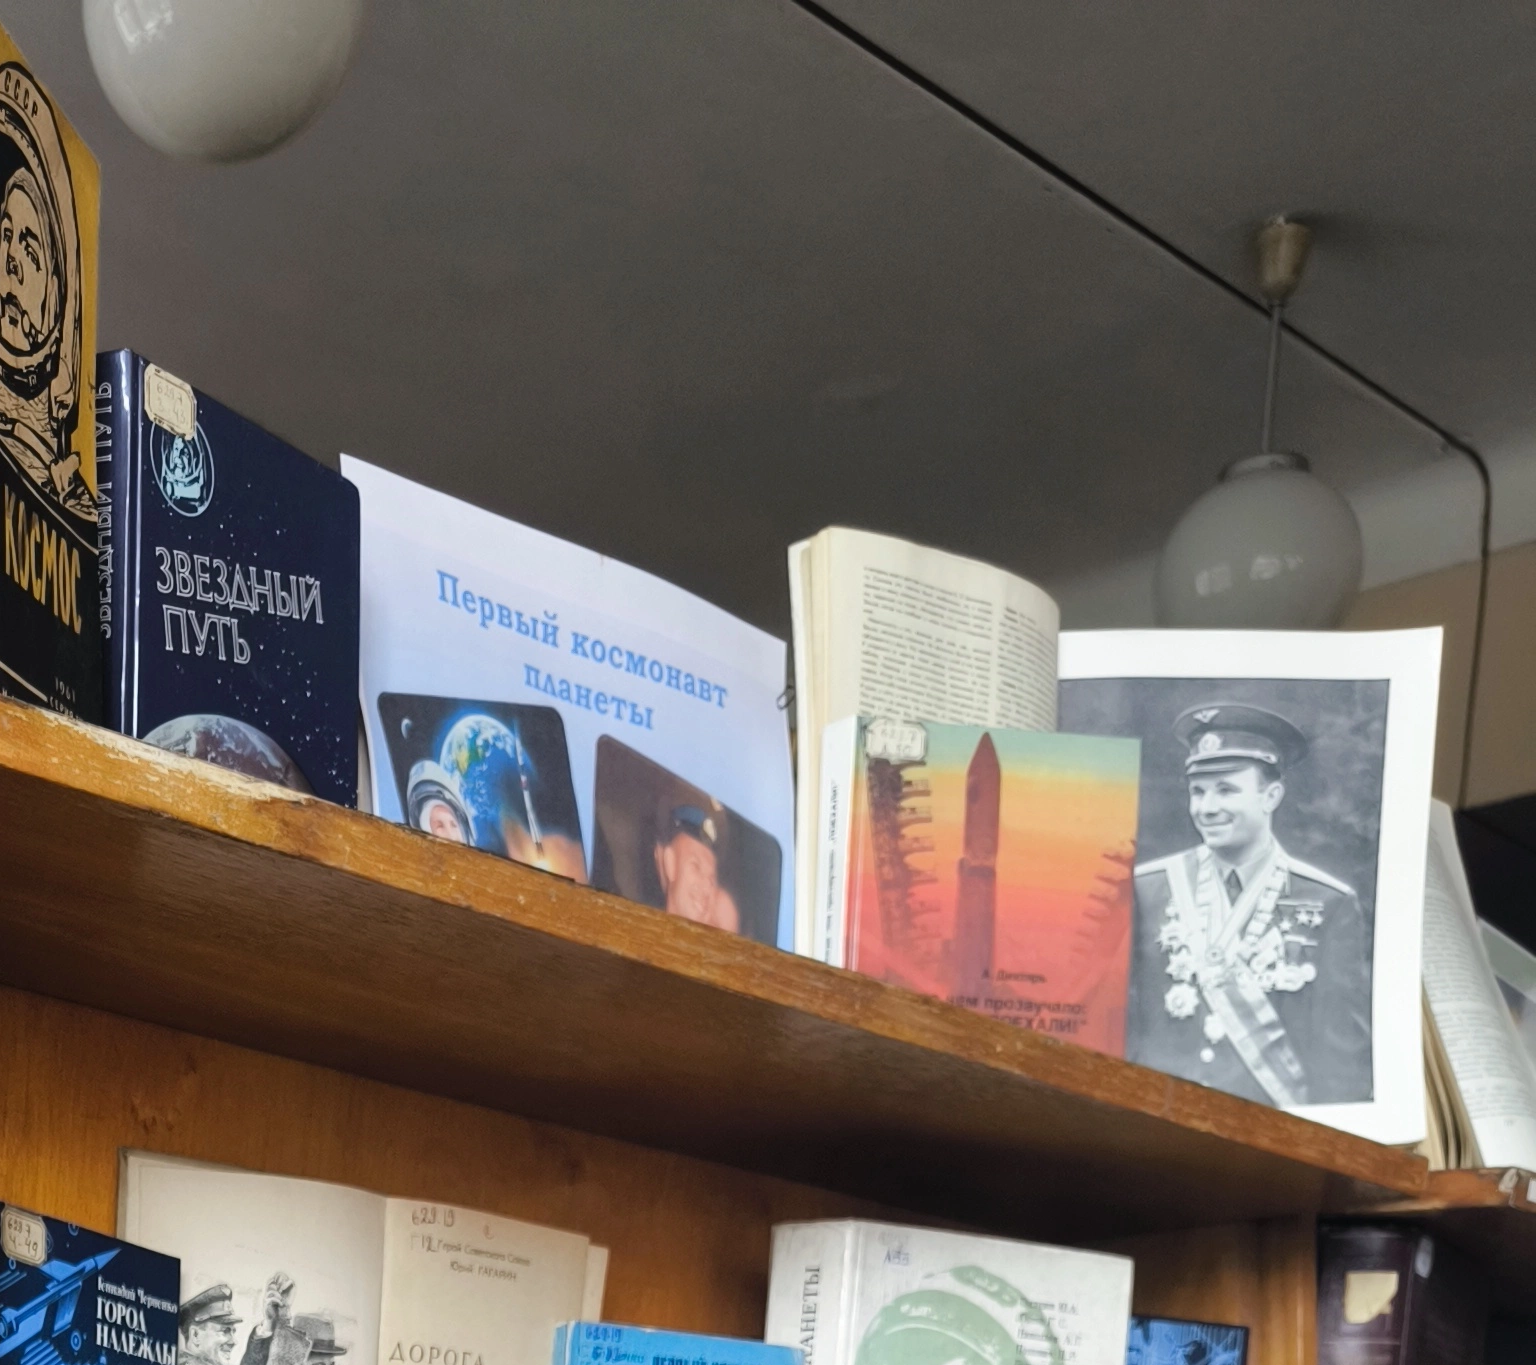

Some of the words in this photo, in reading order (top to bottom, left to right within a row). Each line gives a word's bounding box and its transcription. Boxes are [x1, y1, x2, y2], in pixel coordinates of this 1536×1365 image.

[4, 70, 39, 118] СССР
[4, 484, 82, 635] КОСМОС
[156, 546, 324, 624] ЗВЕЗДНЫЙ
[162, 604, 251, 664] ПУТЬ
[436, 569, 559, 648] Первый
[571, 632, 729, 709] космонавт
[523, 663, 655, 731] планеты
[96, 1295, 147, 1334] ГОРОД
